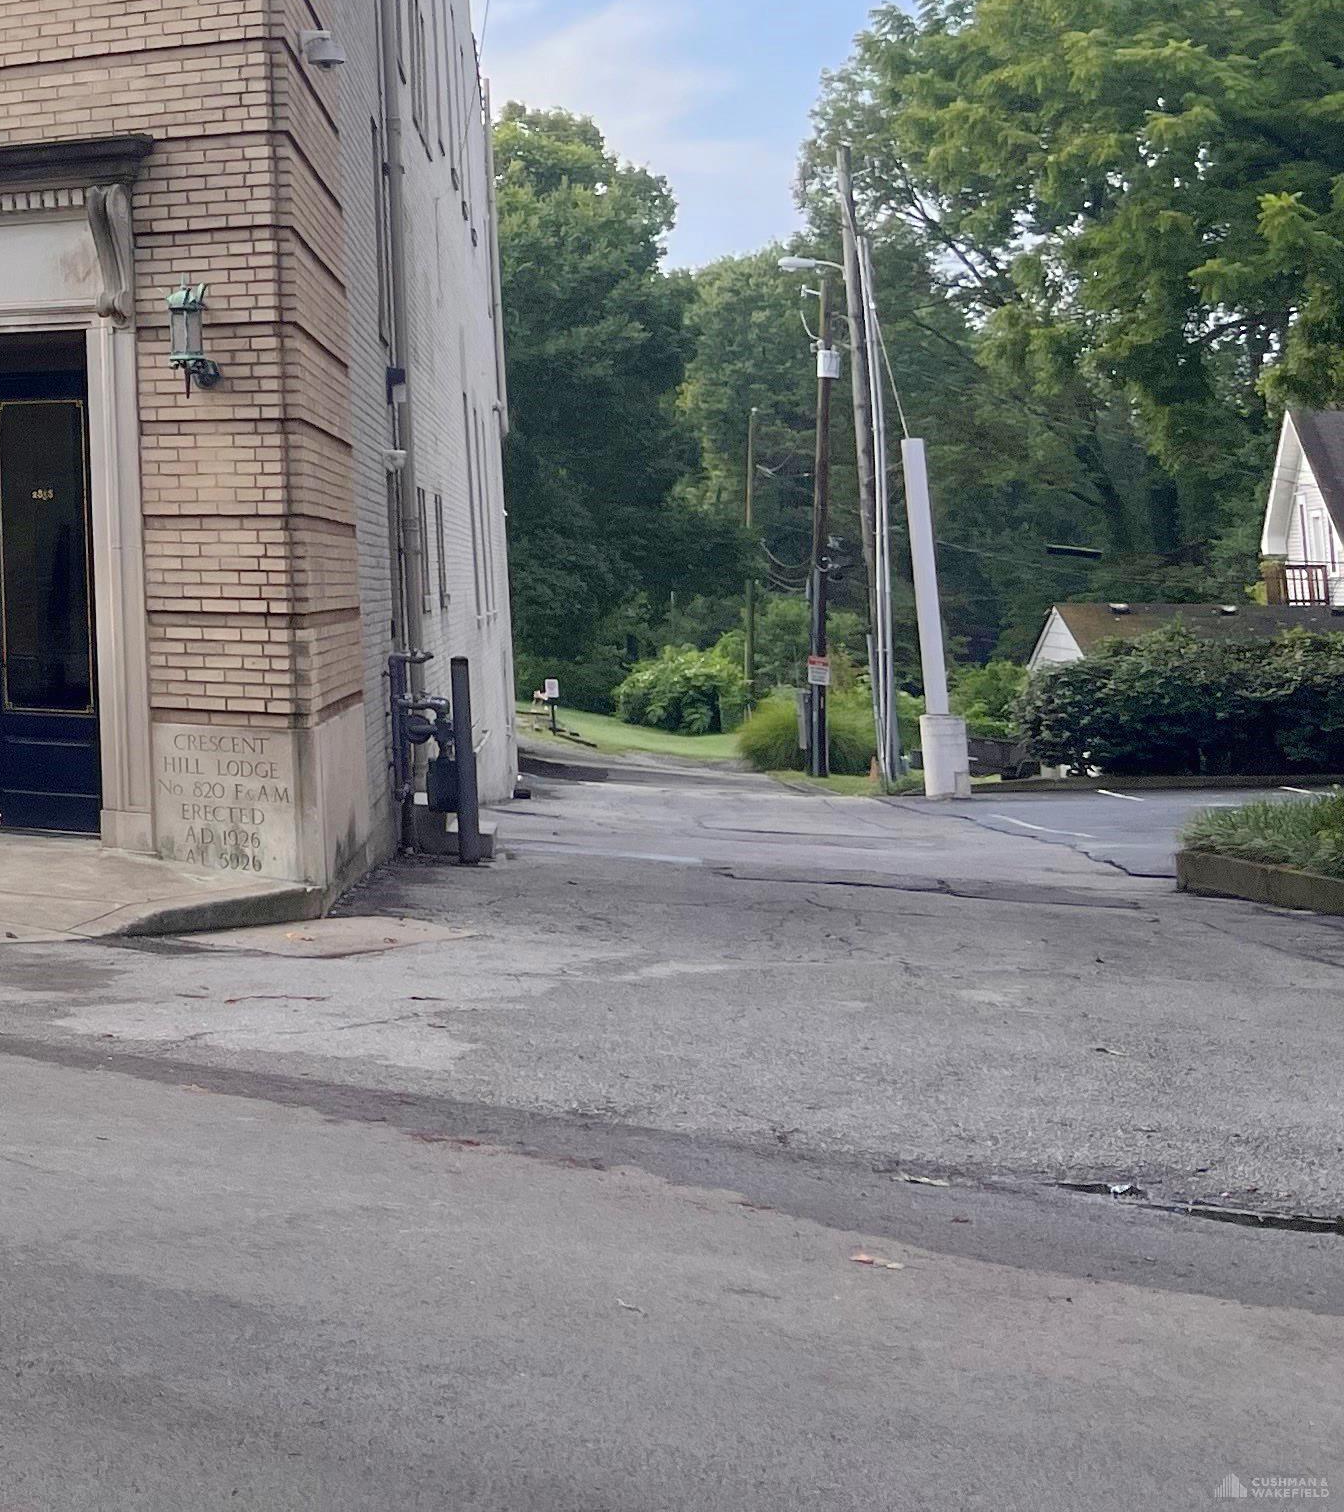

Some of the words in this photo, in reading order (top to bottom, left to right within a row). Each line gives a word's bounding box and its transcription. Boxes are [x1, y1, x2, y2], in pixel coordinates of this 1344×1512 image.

[173, 733, 273, 755] CRESCENT
[163, 756, 205, 776] HILL
[216, 758, 280, 780] LODGE
[192, 781, 226, 800] 820
[181, 802, 265, 826] ERECTED
[223, 829, 261, 849] 1926
[219, 852, 262, 873] 5926
